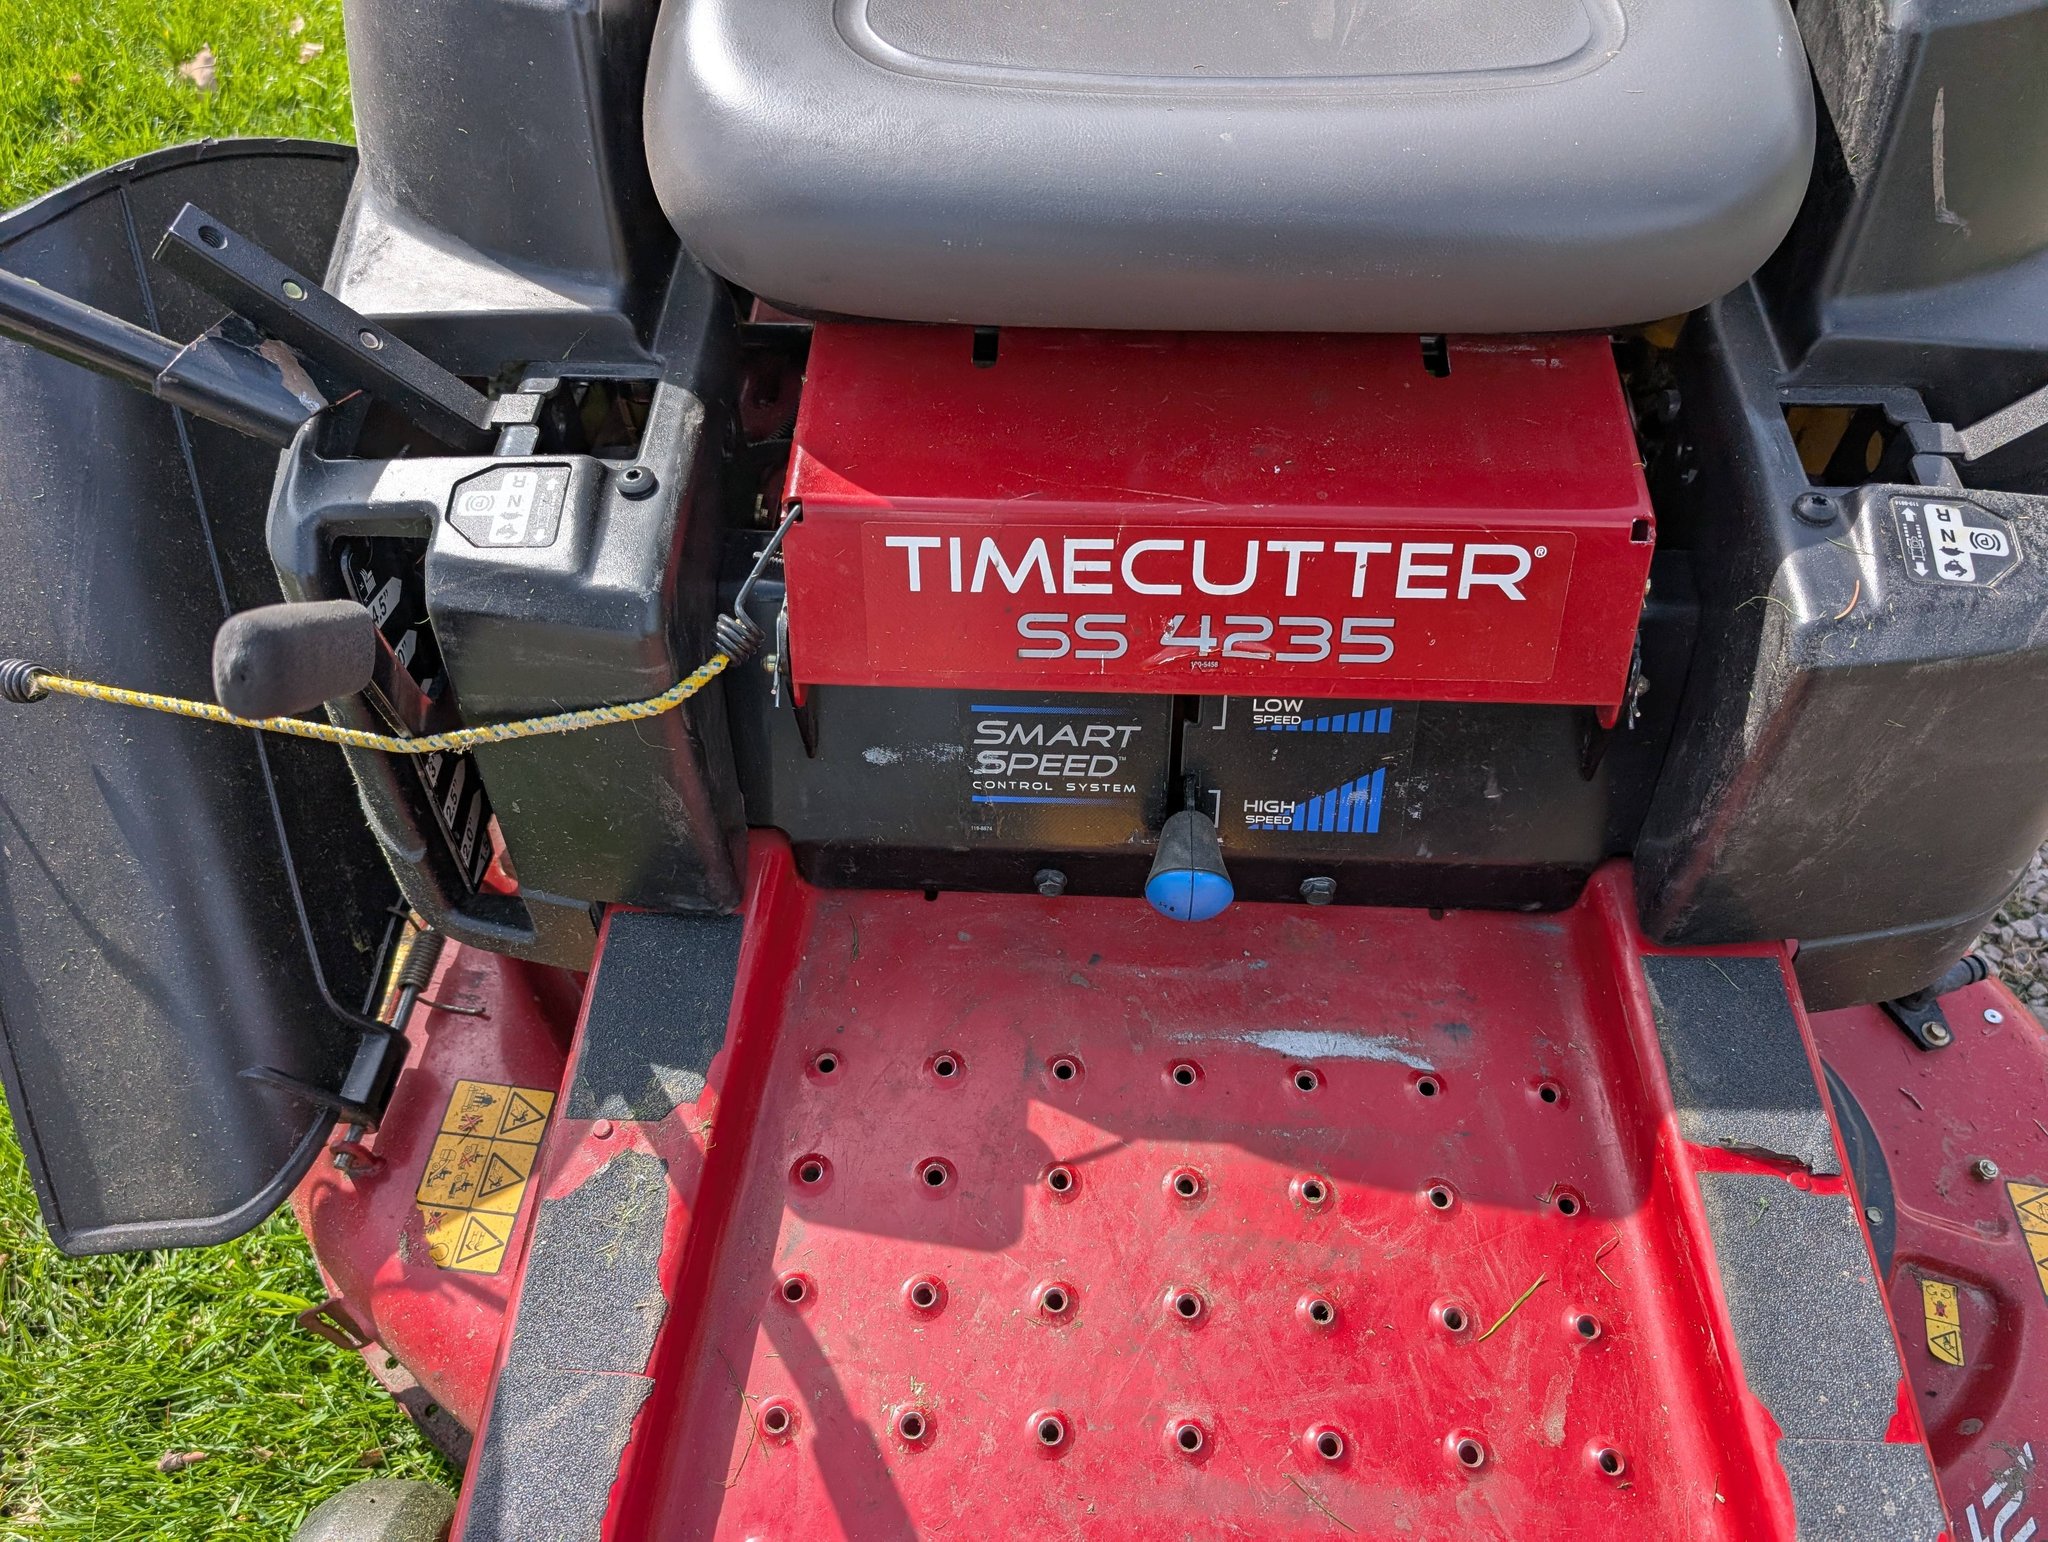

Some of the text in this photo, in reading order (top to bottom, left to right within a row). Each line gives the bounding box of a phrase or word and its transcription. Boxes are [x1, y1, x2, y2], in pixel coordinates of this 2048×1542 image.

[507, 495, 522, 508] N
[1935, 508, 1950, 522] R
[1941, 529, 1956, 543] N
[1016, 613, 1395, 663] SS 4235
[1252, 698, 1303, 712] LOW
[1253, 714, 1302, 725] SPEED
[973, 720, 1142, 748] SMART
[972, 780, 1136, 793] CONTROL SYSTEM
[1243, 799, 1295, 813] HIGH
[1245, 815, 1292, 825] SPEED
